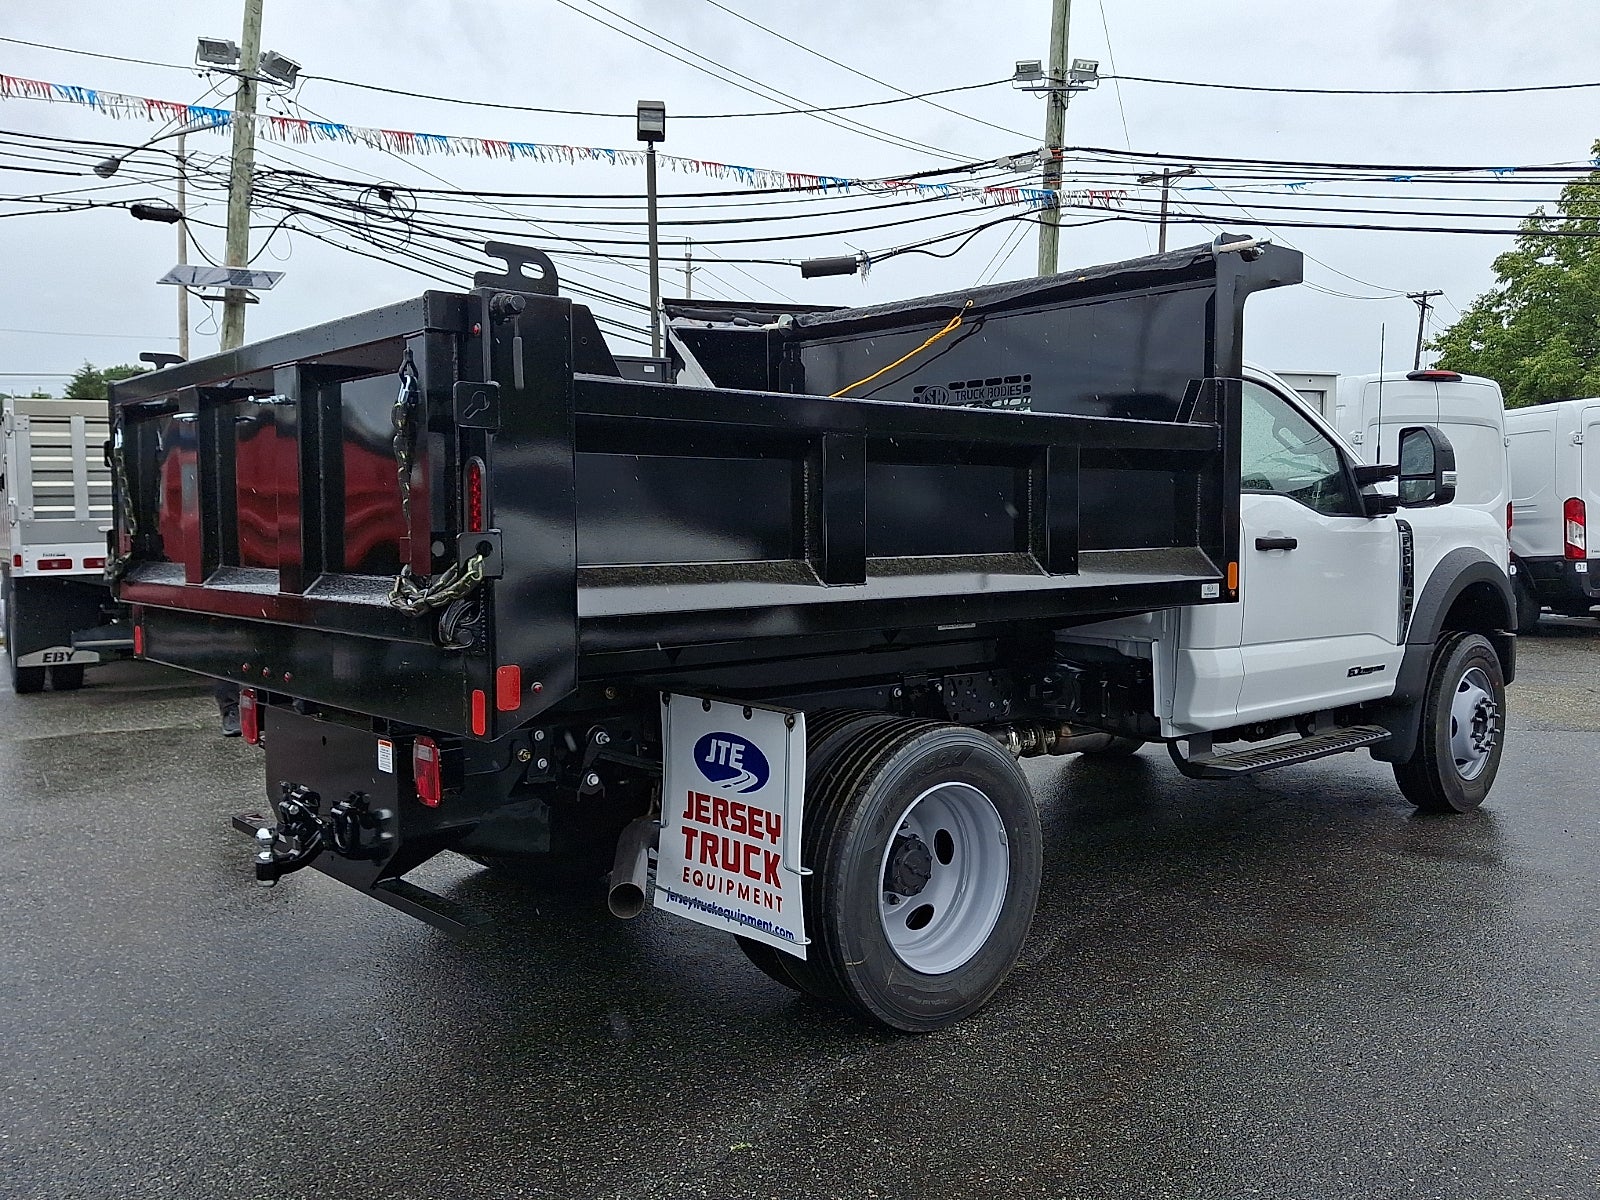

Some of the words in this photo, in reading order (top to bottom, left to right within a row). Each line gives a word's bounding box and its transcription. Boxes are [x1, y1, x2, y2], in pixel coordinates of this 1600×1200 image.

[955, 389, 985, 401] TRUCK
[987, 384, 1022, 398] BODIES
[42, 652, 75, 663] EBY
[705, 738, 746, 769] JTE
[683, 790, 782, 845] JERSEY
[681, 825, 783, 889] TRUCK
[666, 886, 795, 940] jerseytruckequipment.com
[682, 866, 783, 913] EQUIPMENT
